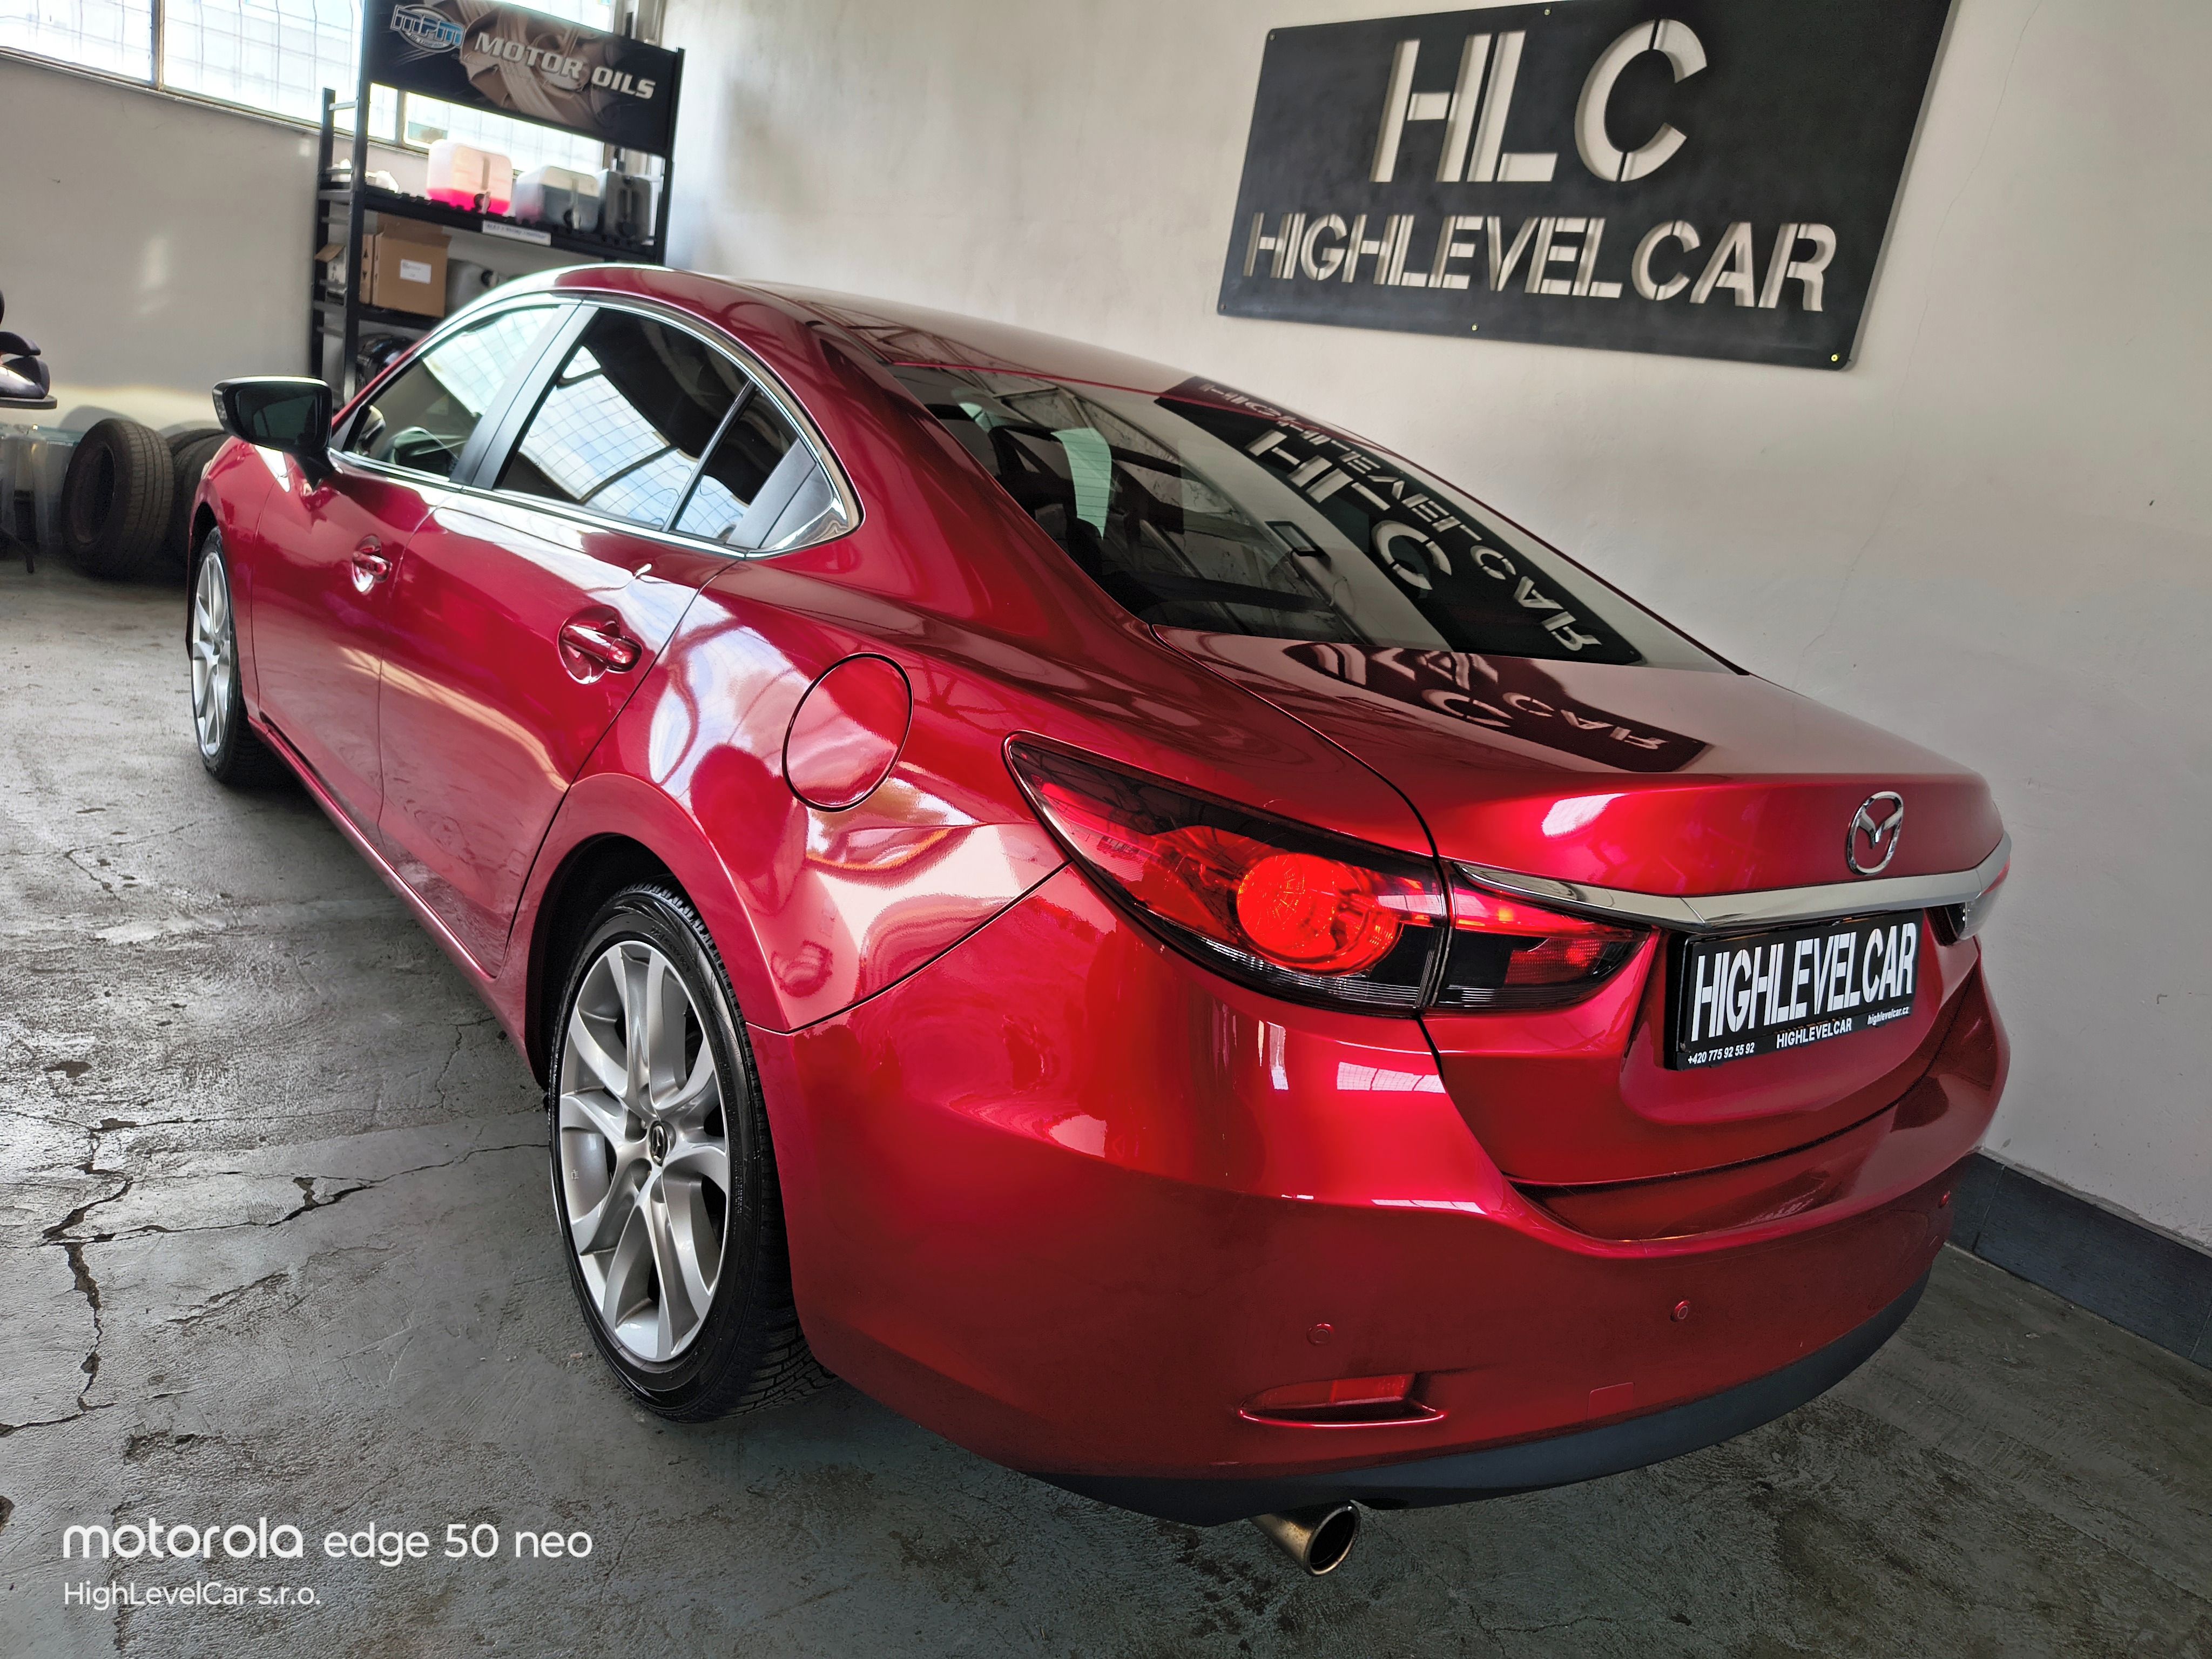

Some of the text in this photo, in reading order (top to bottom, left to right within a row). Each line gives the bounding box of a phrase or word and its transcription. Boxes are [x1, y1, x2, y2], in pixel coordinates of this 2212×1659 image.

[474, 32, 583, 80] MOTOR
[590, 66, 656, 99] OILS
[1368, 17, 1707, 183] HLC
[1867, 1006, 1910, 1026] highlevelcar.cz
[1776, 1017, 1852, 1049] HIGHLEVELCAR
[1688, 1042, 1755, 1064] +420 775 92 55 92
